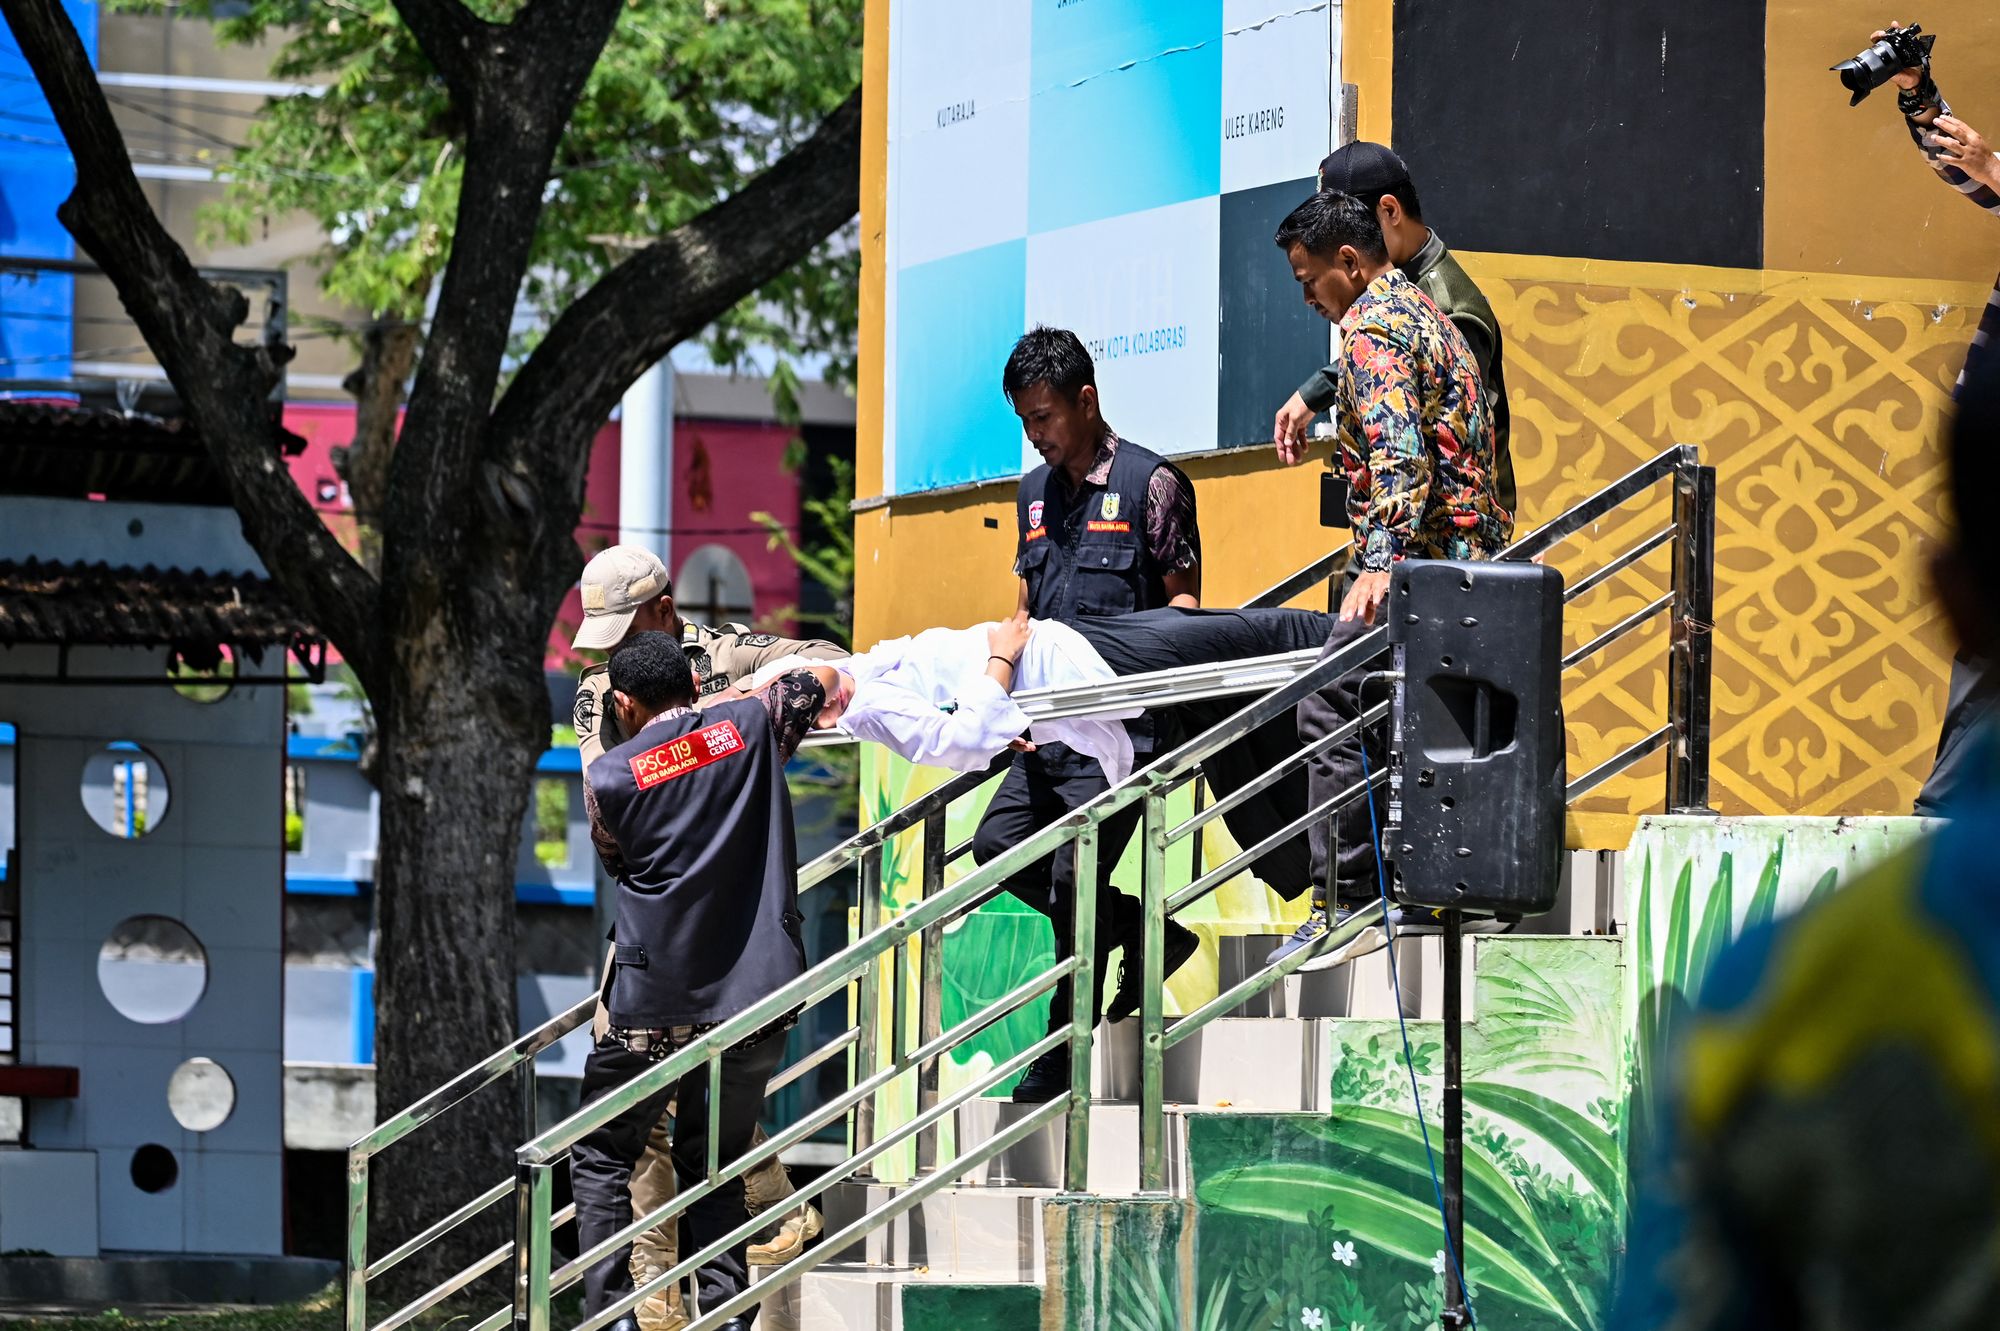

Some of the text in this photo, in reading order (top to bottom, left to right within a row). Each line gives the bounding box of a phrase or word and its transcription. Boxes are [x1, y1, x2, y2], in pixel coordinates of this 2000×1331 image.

[937, 99, 975, 128] KUTARAJA
[1225, 106, 1284, 140] ULEE KARENG
[1107, 336, 1129, 360] KOTA
[1133, 325, 1186, 356] KOLABORASI
[702, 725, 730, 740] PUBLIC
[706, 732, 734, 748] SAFETY
[636, 740, 692, 776] PSC 119
[709, 739, 739, 756] CENTER
[642, 757, 698, 784] KOTA BANDA ACEH
